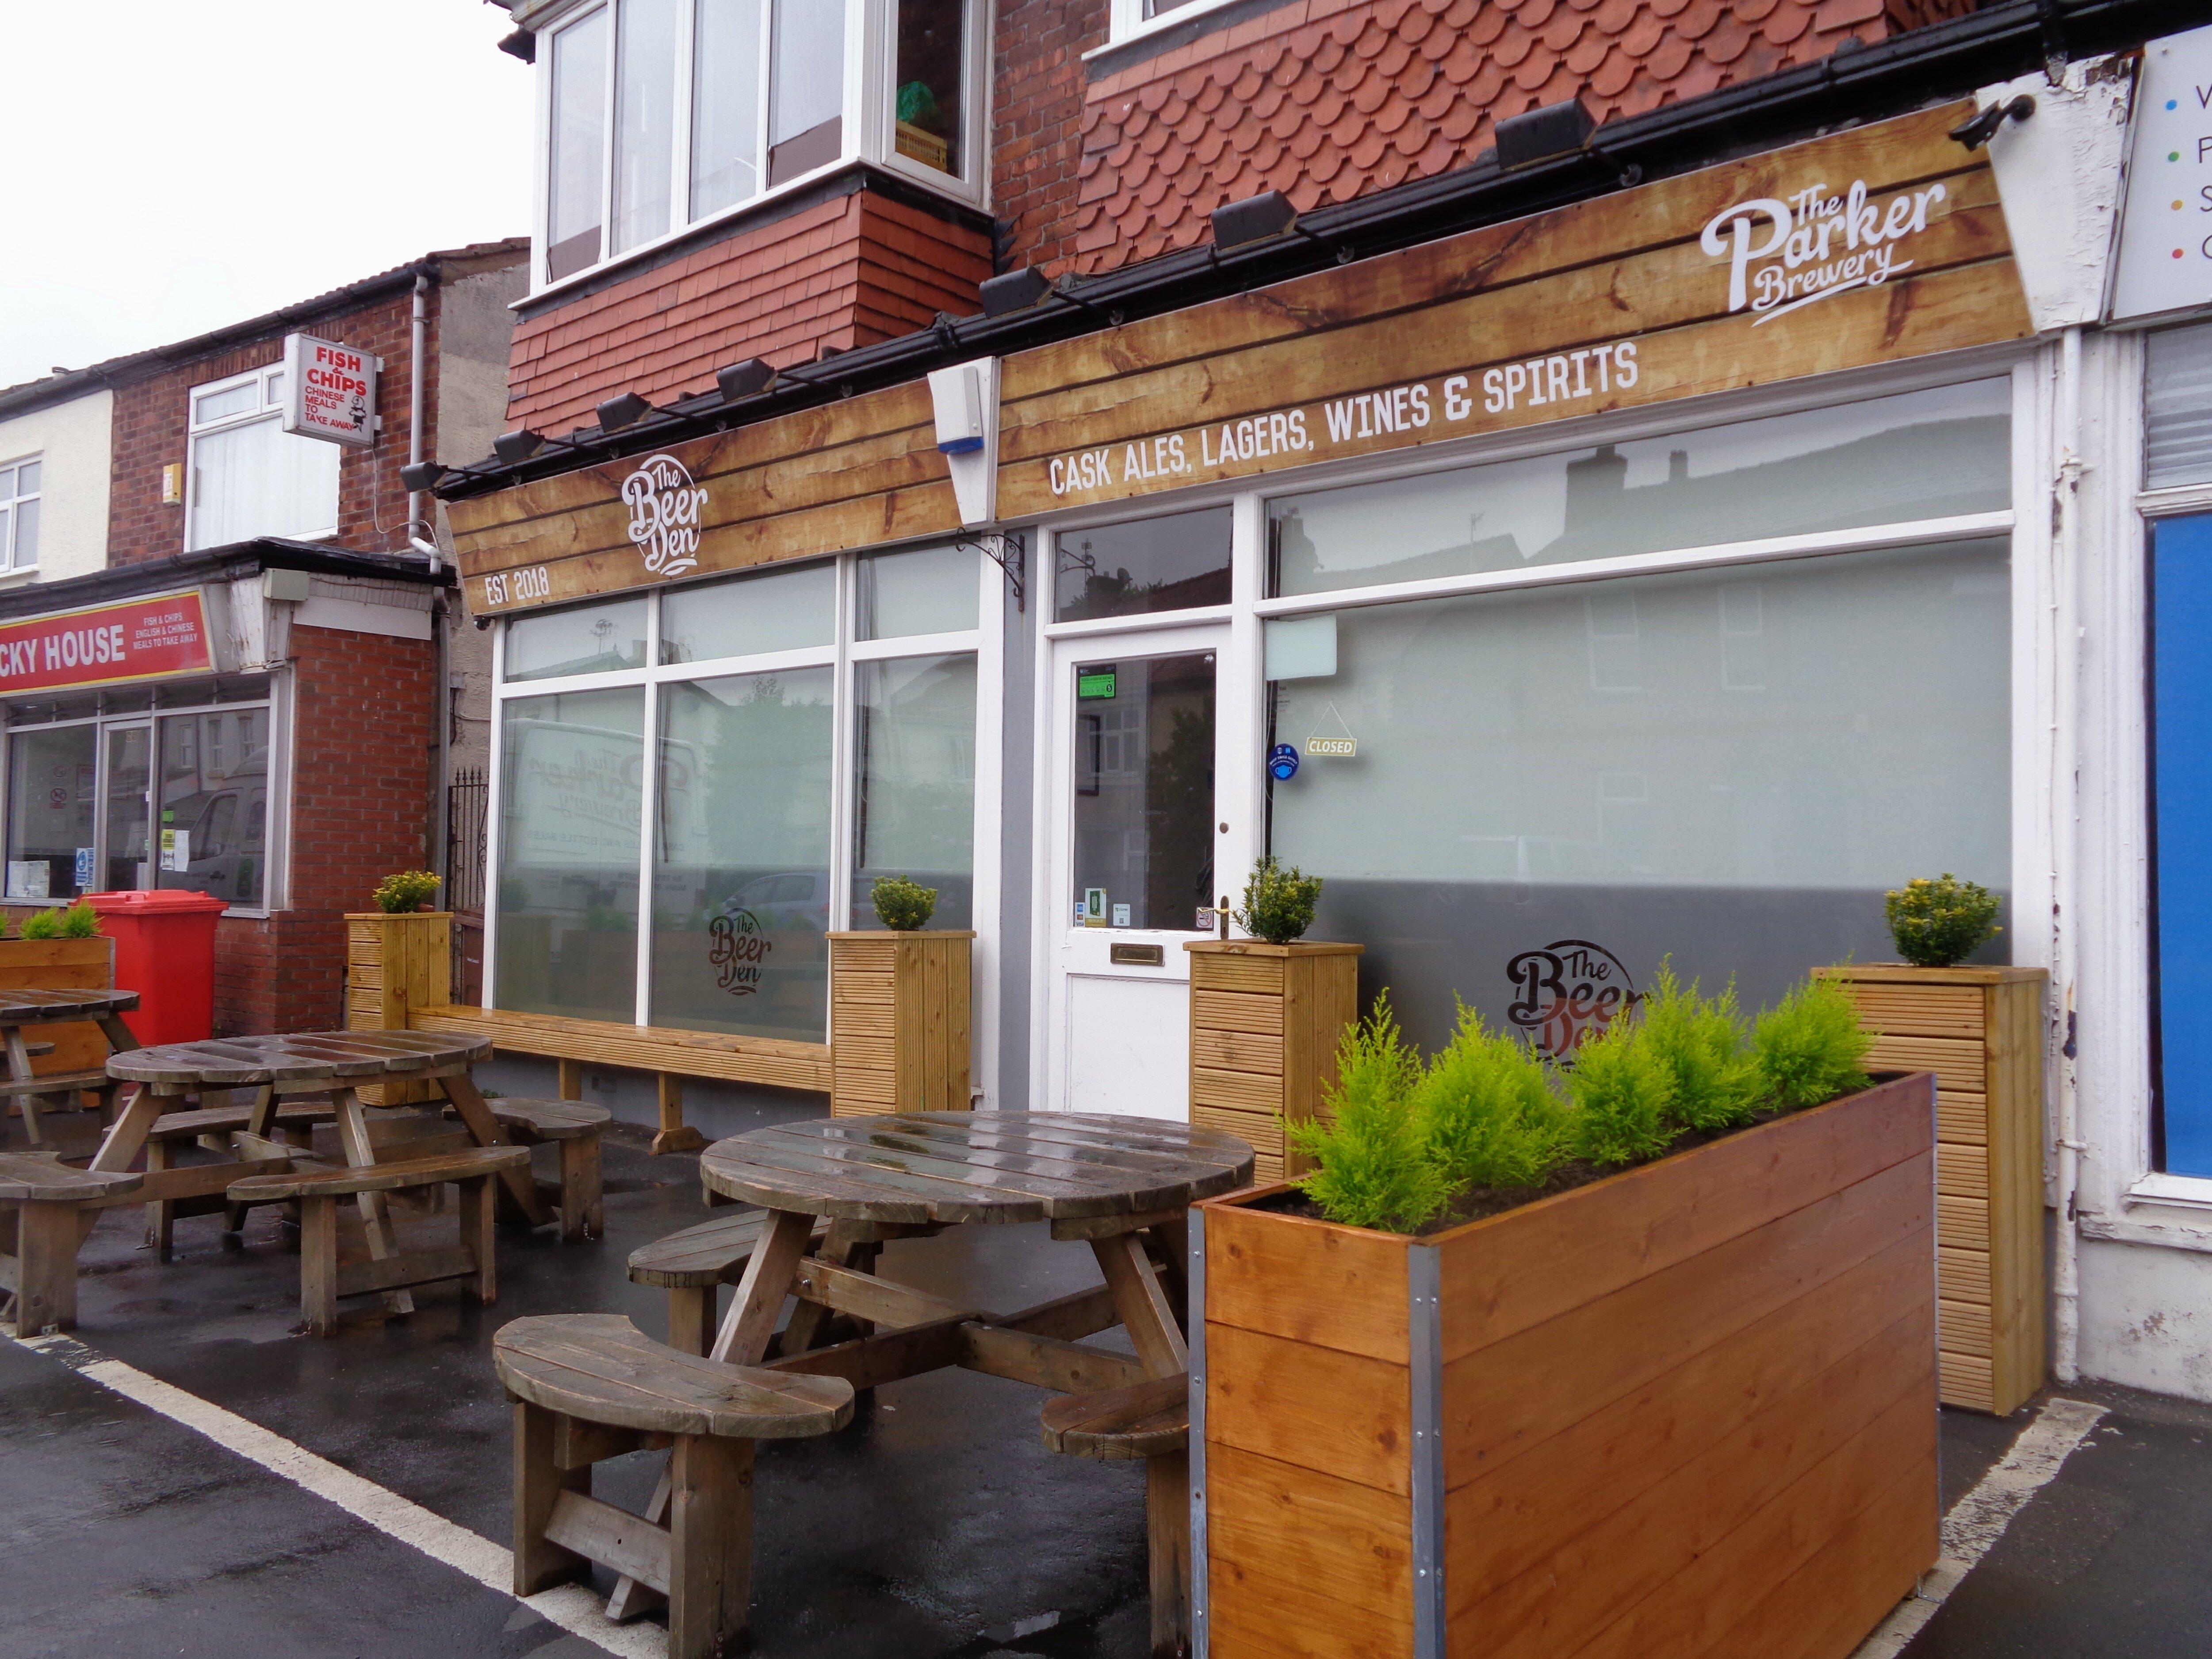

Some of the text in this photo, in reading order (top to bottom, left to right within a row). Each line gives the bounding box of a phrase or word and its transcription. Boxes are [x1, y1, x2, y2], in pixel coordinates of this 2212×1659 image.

[1789, 183, 1844, 226] The
[1700, 179, 1946, 312] Parker
[1752, 243, 1914, 311] Brewery
[317, 346, 361, 372] FISH
[332, 367, 344, 375] &
[305, 386, 344, 402] CHINESE
[307, 368, 366, 396] CHIPS
[306, 395, 337, 409] MEALS
[306, 404, 318, 413] TO
[305, 413, 353, 431] TAKE AWAY
[1050, 341, 1638, 494] CASK ALES, LAGERS, WINES & SPIRITS
[651, 462, 681, 490] The
[622, 470, 708, 543] Beer
[642, 519, 699, 571] Den
[485, 566, 550, 605] EST 2018
[135, 622, 195, 638] ENGLISH & CHINESE
[144, 612, 183, 626] FISH & CHIPS
[46, 624, 126, 670] HOUSE
[134, 633, 198, 650] MEALS TO TAKE AWAY
[1309, 741, 1352, 753] CLOSED
[733, 914, 754, 935] The
[709, 915, 772, 964] Beer
[717, 957, 762, 988] Den
[1562, 949, 1611, 981] The
[1507, 951, 1653, 1026] Beer
